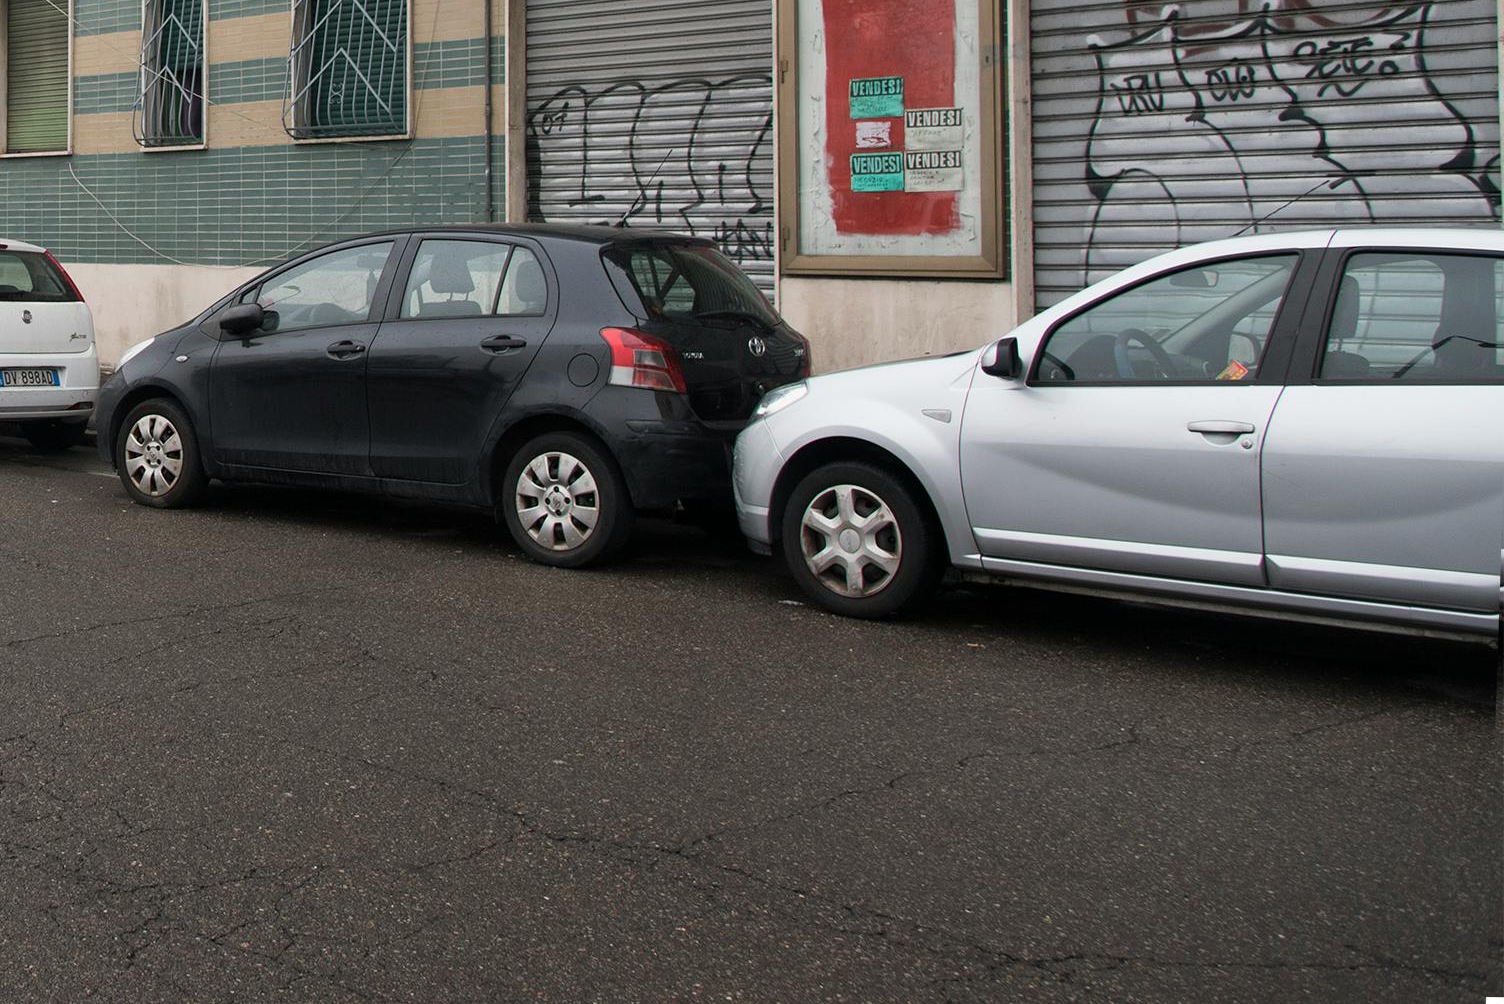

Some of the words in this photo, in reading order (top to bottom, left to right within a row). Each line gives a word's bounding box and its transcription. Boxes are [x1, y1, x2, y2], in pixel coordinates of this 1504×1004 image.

[852, 79, 901, 96] VENDESI
[907, 110, 961, 127] VENDESI
[853, 155, 901, 173] VENDESI
[907, 152, 961, 169] VENDESI
[4, 371, 17, 384] DV
[21, 371, 53, 384] 898AD
